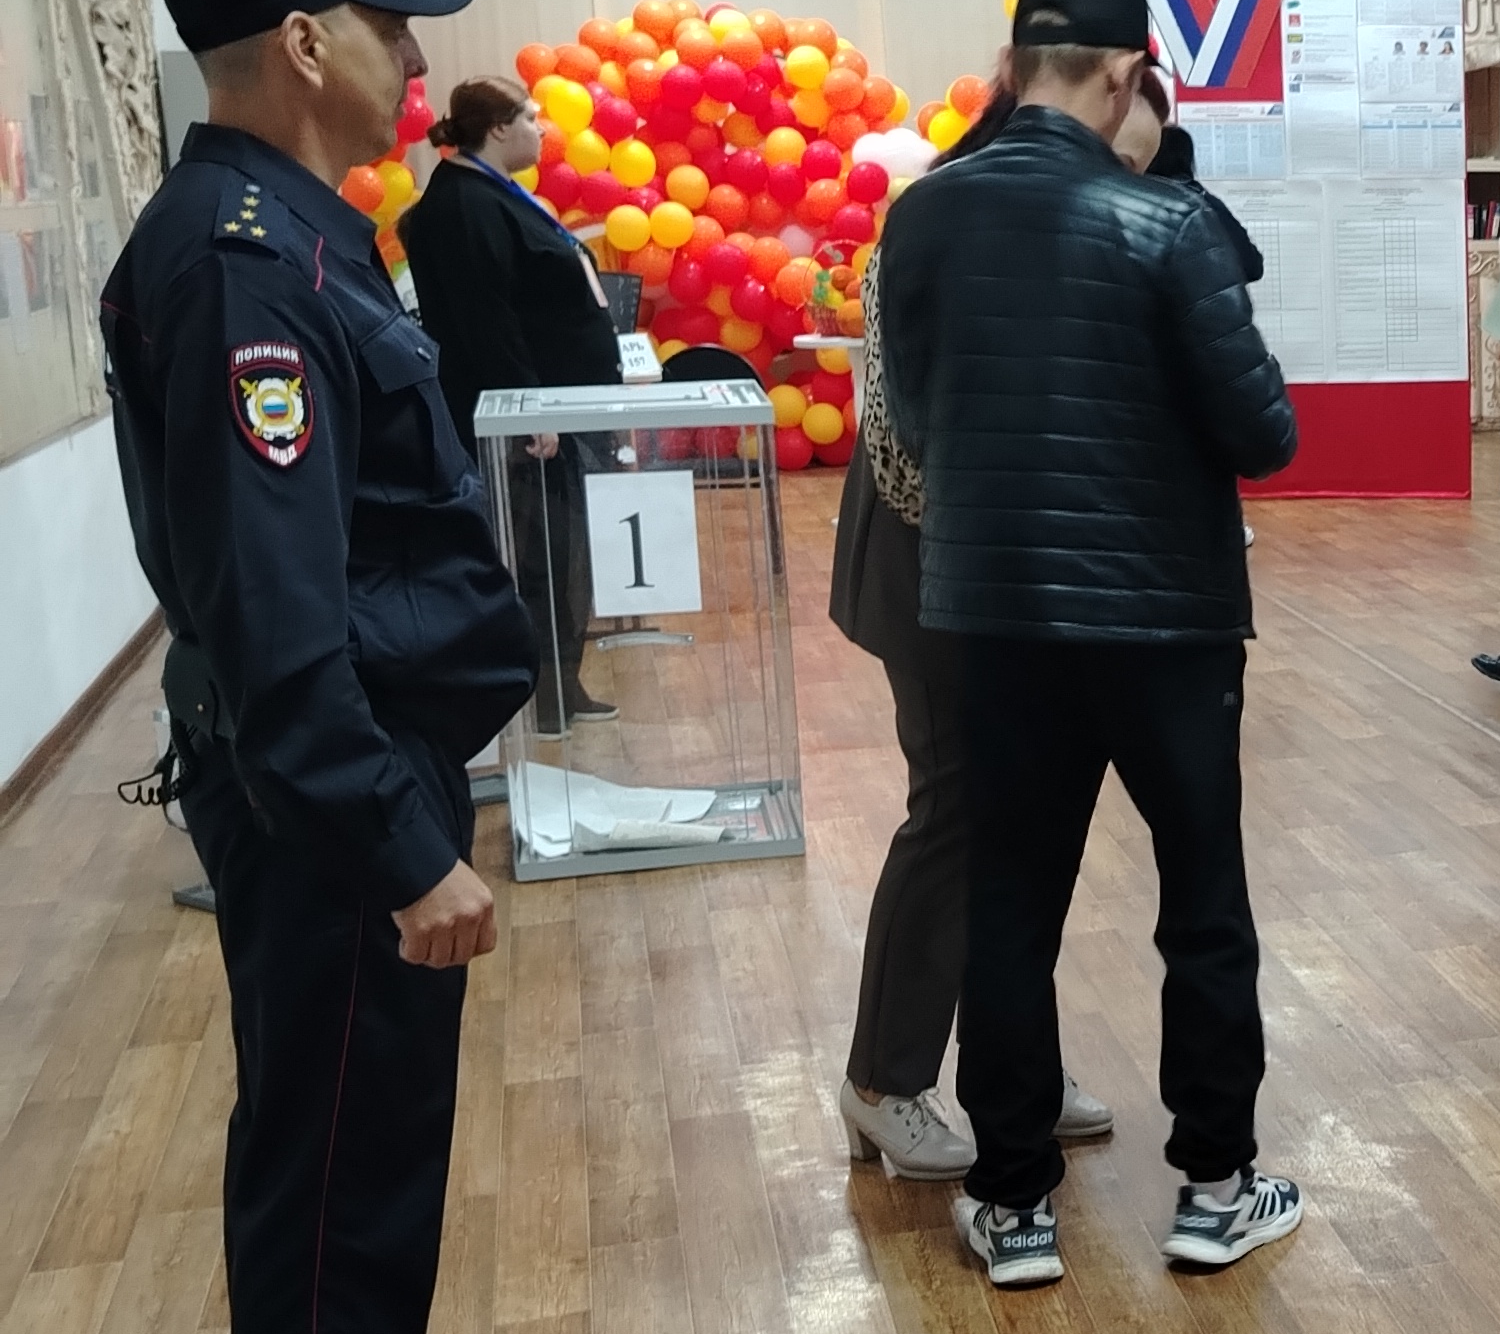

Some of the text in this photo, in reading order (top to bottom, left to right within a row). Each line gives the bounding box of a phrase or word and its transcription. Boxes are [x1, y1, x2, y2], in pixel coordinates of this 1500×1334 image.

[234, 344, 300, 366] ПОЛИЦИЯ
[268, 443, 298, 466] МВД
[618, 511, 655, 590] 1
[1002, 1230, 1054, 1248] adidas
